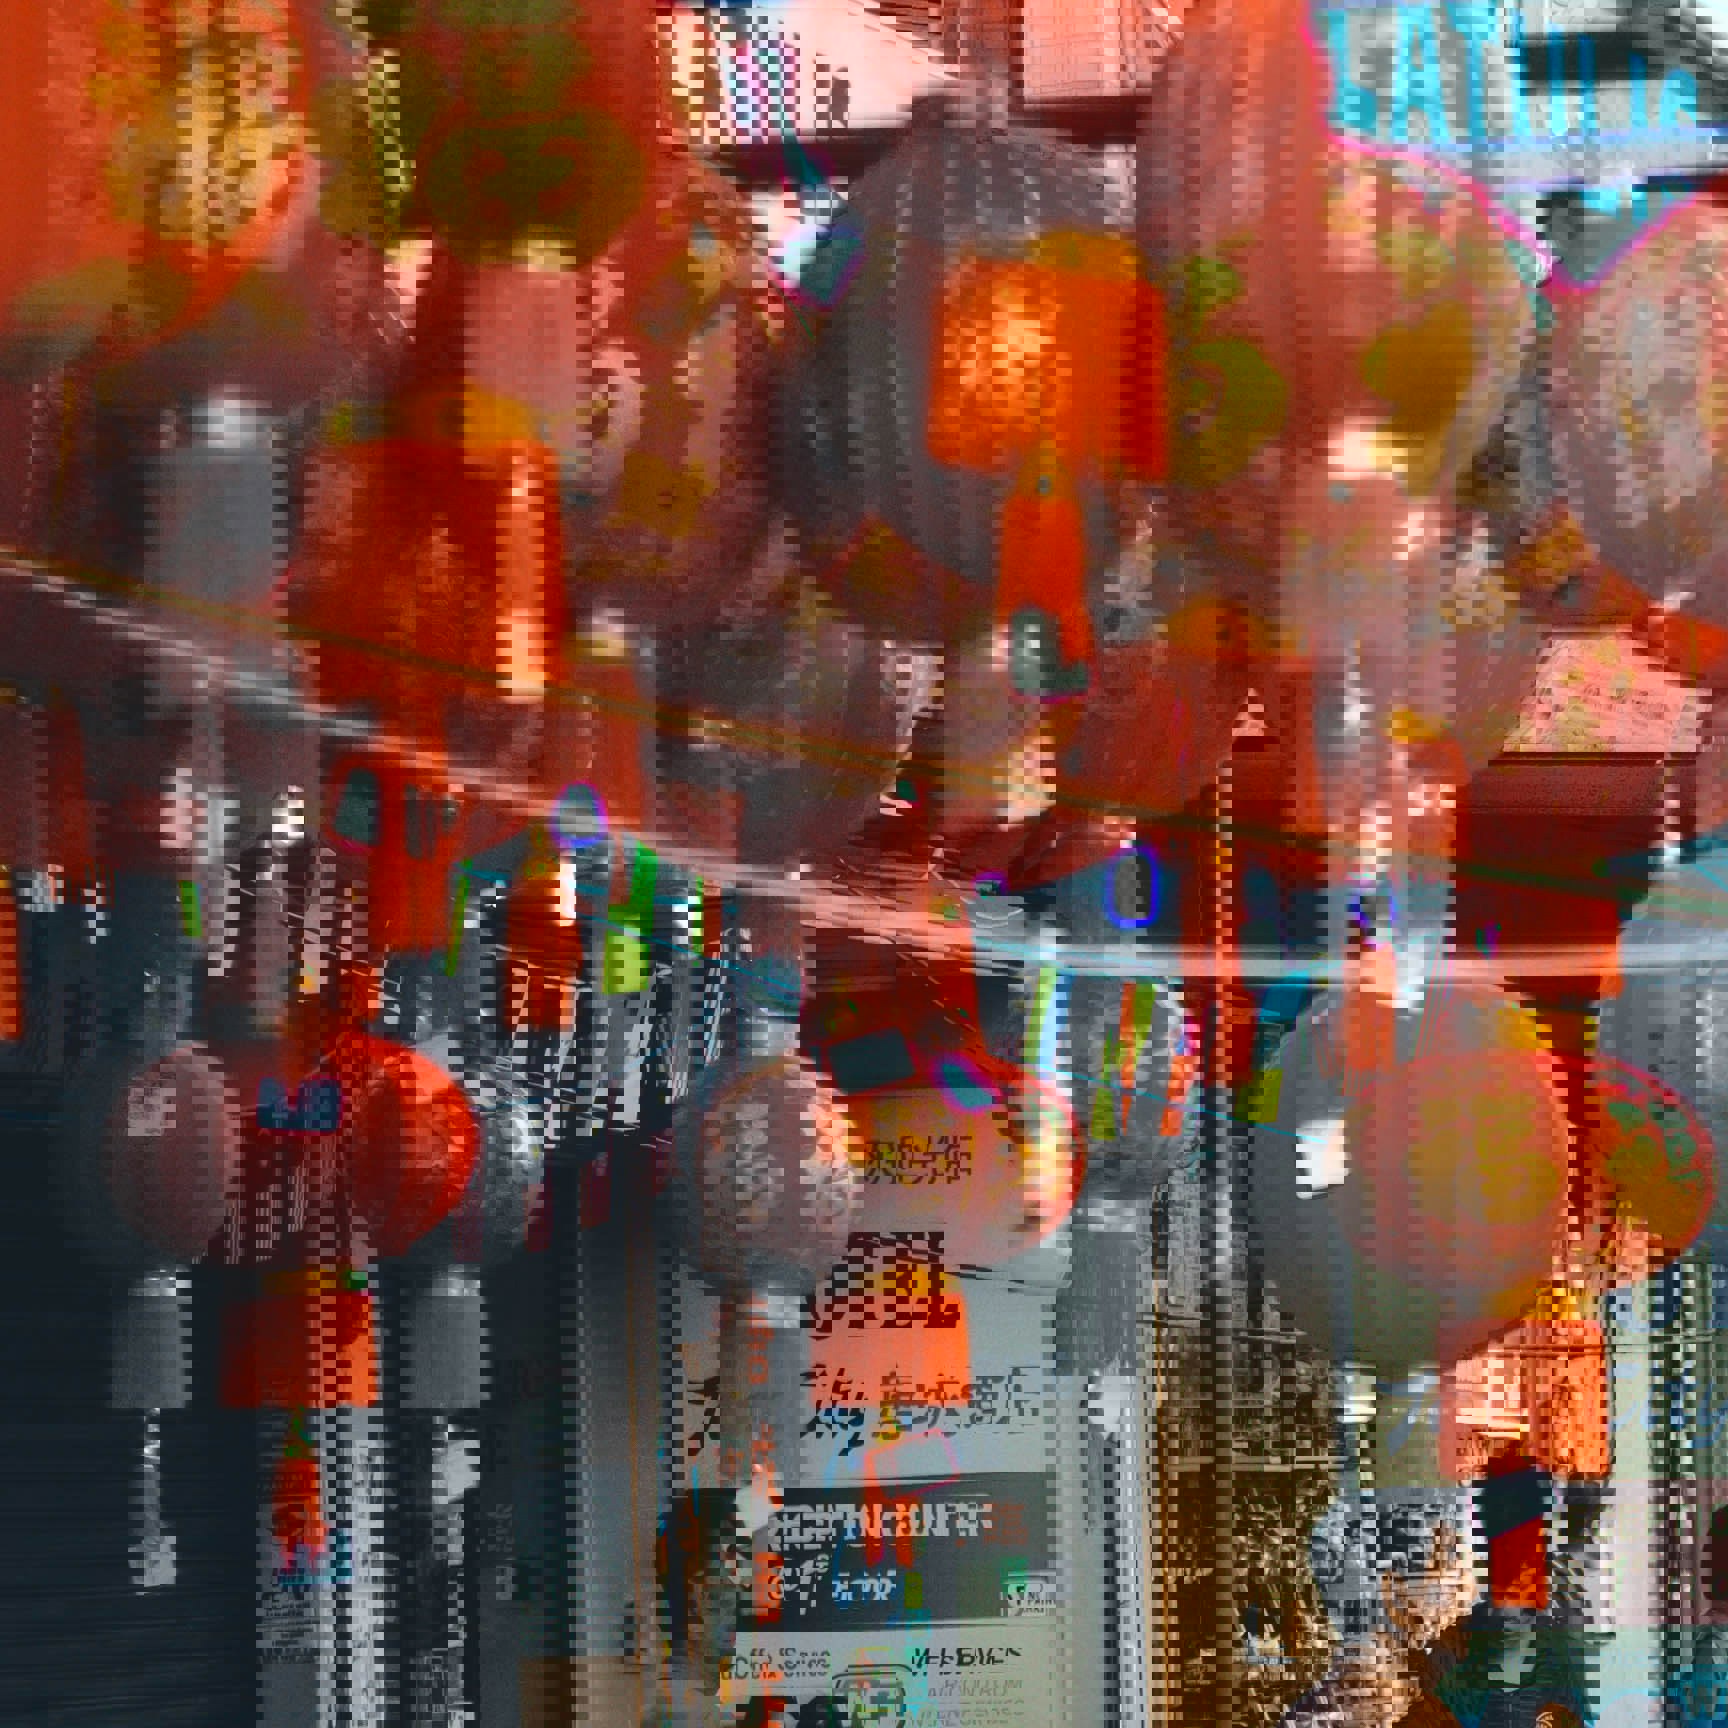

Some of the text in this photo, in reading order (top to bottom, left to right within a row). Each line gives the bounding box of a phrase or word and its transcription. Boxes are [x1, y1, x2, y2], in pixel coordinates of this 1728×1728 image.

[1405, 1092, 1558, 1227] 福
[533, 1577, 617, 1603] CCTV
[1485, 1647, 1539, 1673] Offer
[1545, 1646, 1561, 1671] &
[1568, 1644, 1661, 1671] Services
